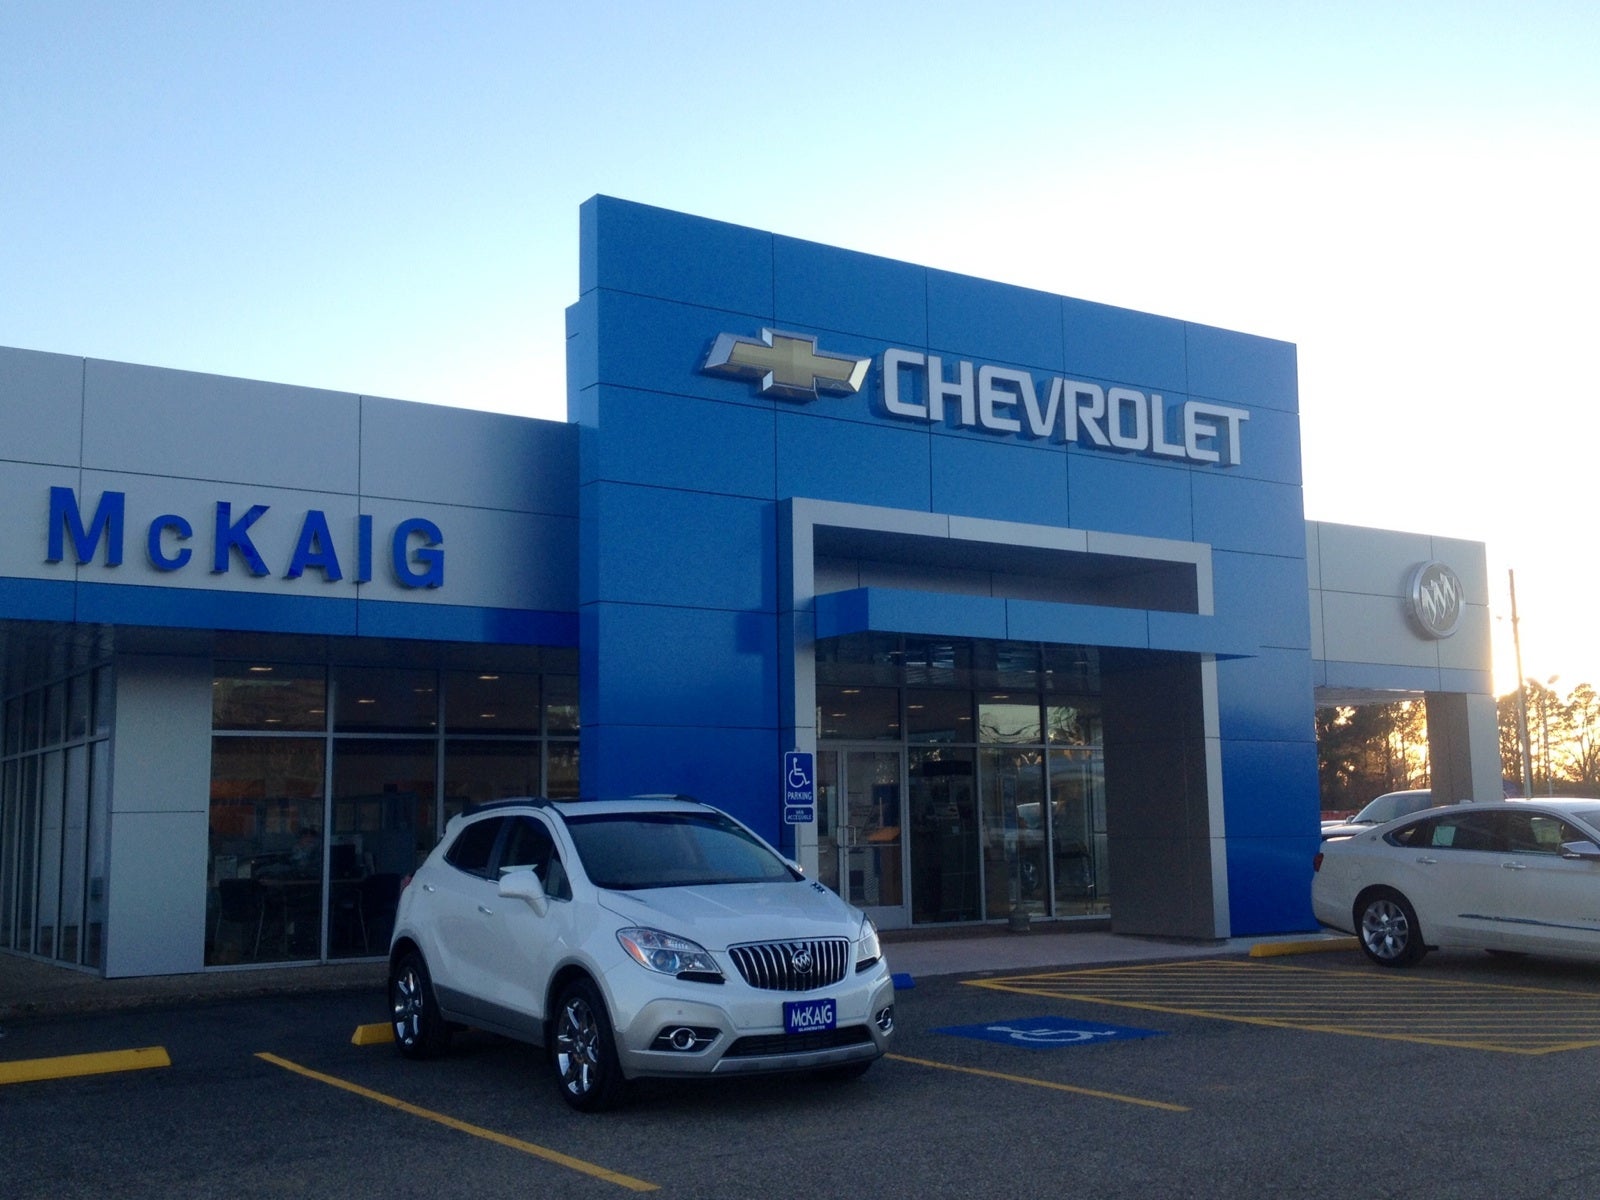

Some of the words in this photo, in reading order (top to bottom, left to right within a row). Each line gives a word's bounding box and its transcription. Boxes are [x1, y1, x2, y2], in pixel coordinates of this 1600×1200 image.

[880, 348, 1250, 466] CHEVROLET
[46, 486, 444, 588] McKAIG
[787, 791, 812, 800] PARKING
[791, 1004, 833, 1028] McKAIG
